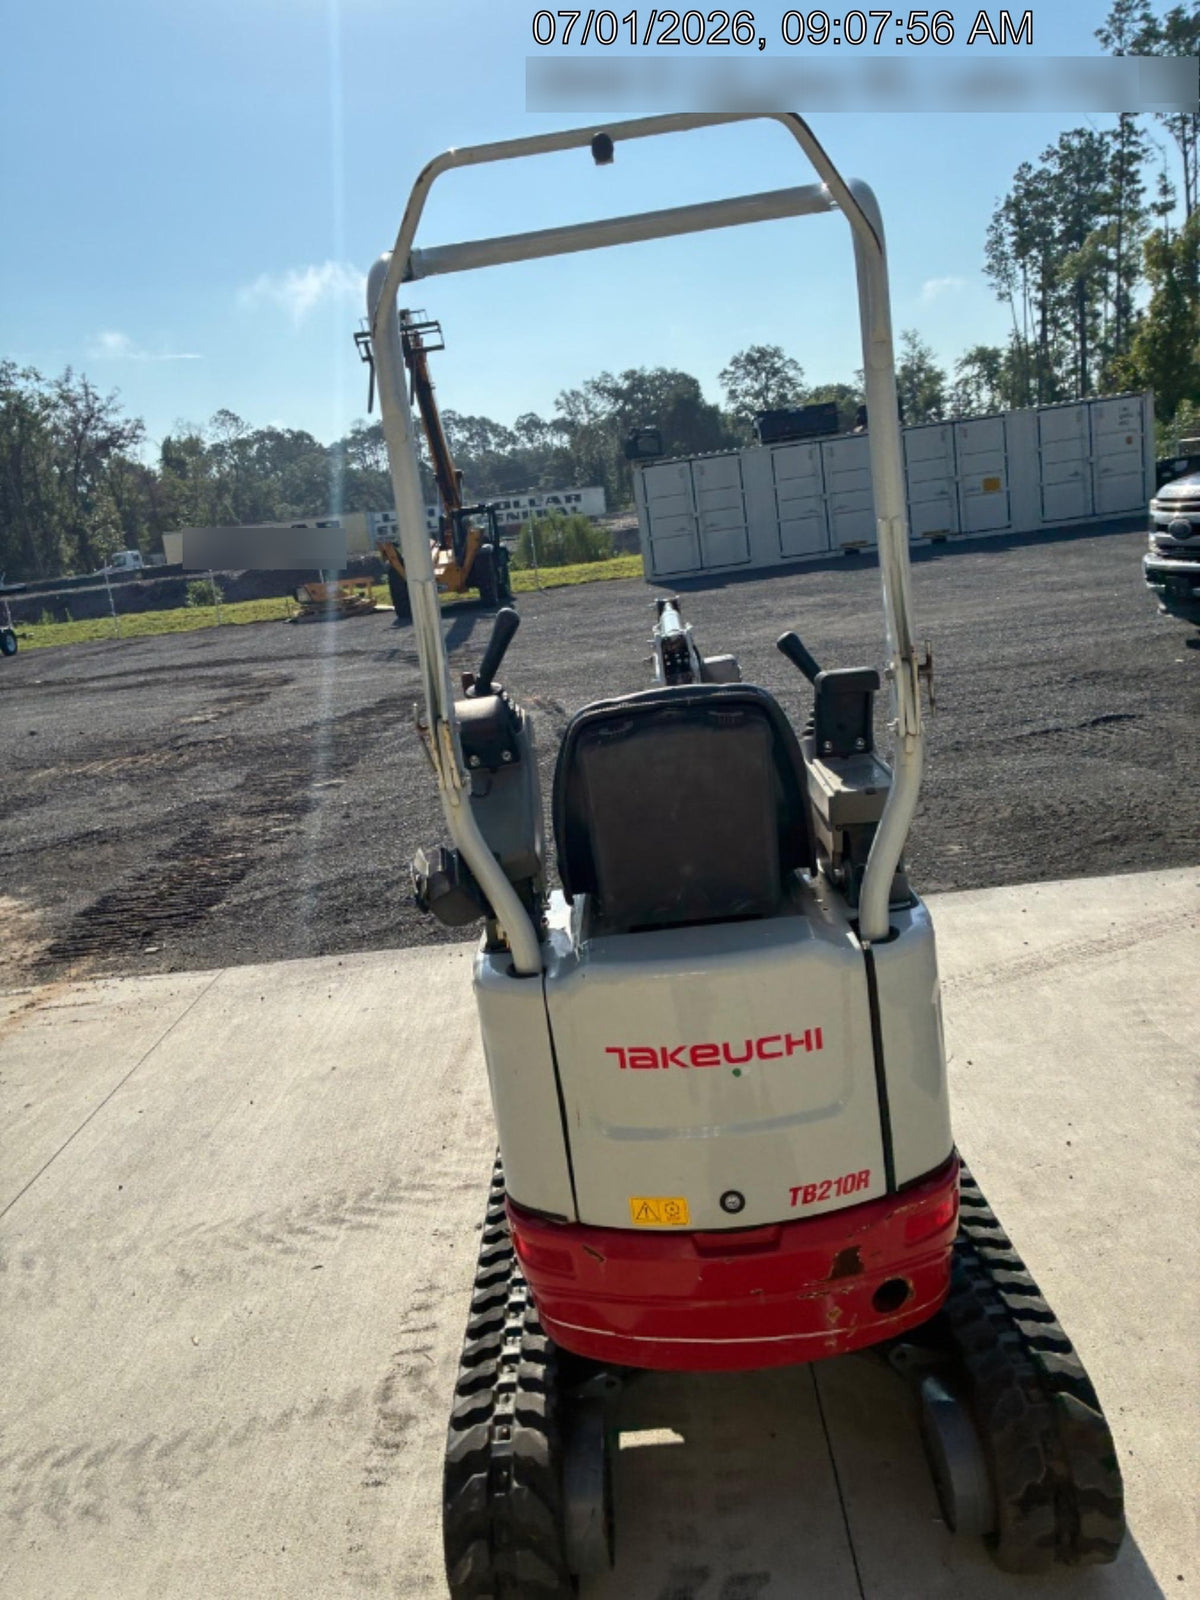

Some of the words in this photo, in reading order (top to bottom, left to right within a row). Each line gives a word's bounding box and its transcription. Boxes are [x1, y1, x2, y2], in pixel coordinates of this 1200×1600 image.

[496, 493, 582, 510] OLLAR
[605, 1027, 824, 1071] TAKEUCHI
[789, 1169, 871, 1208] TB210R
